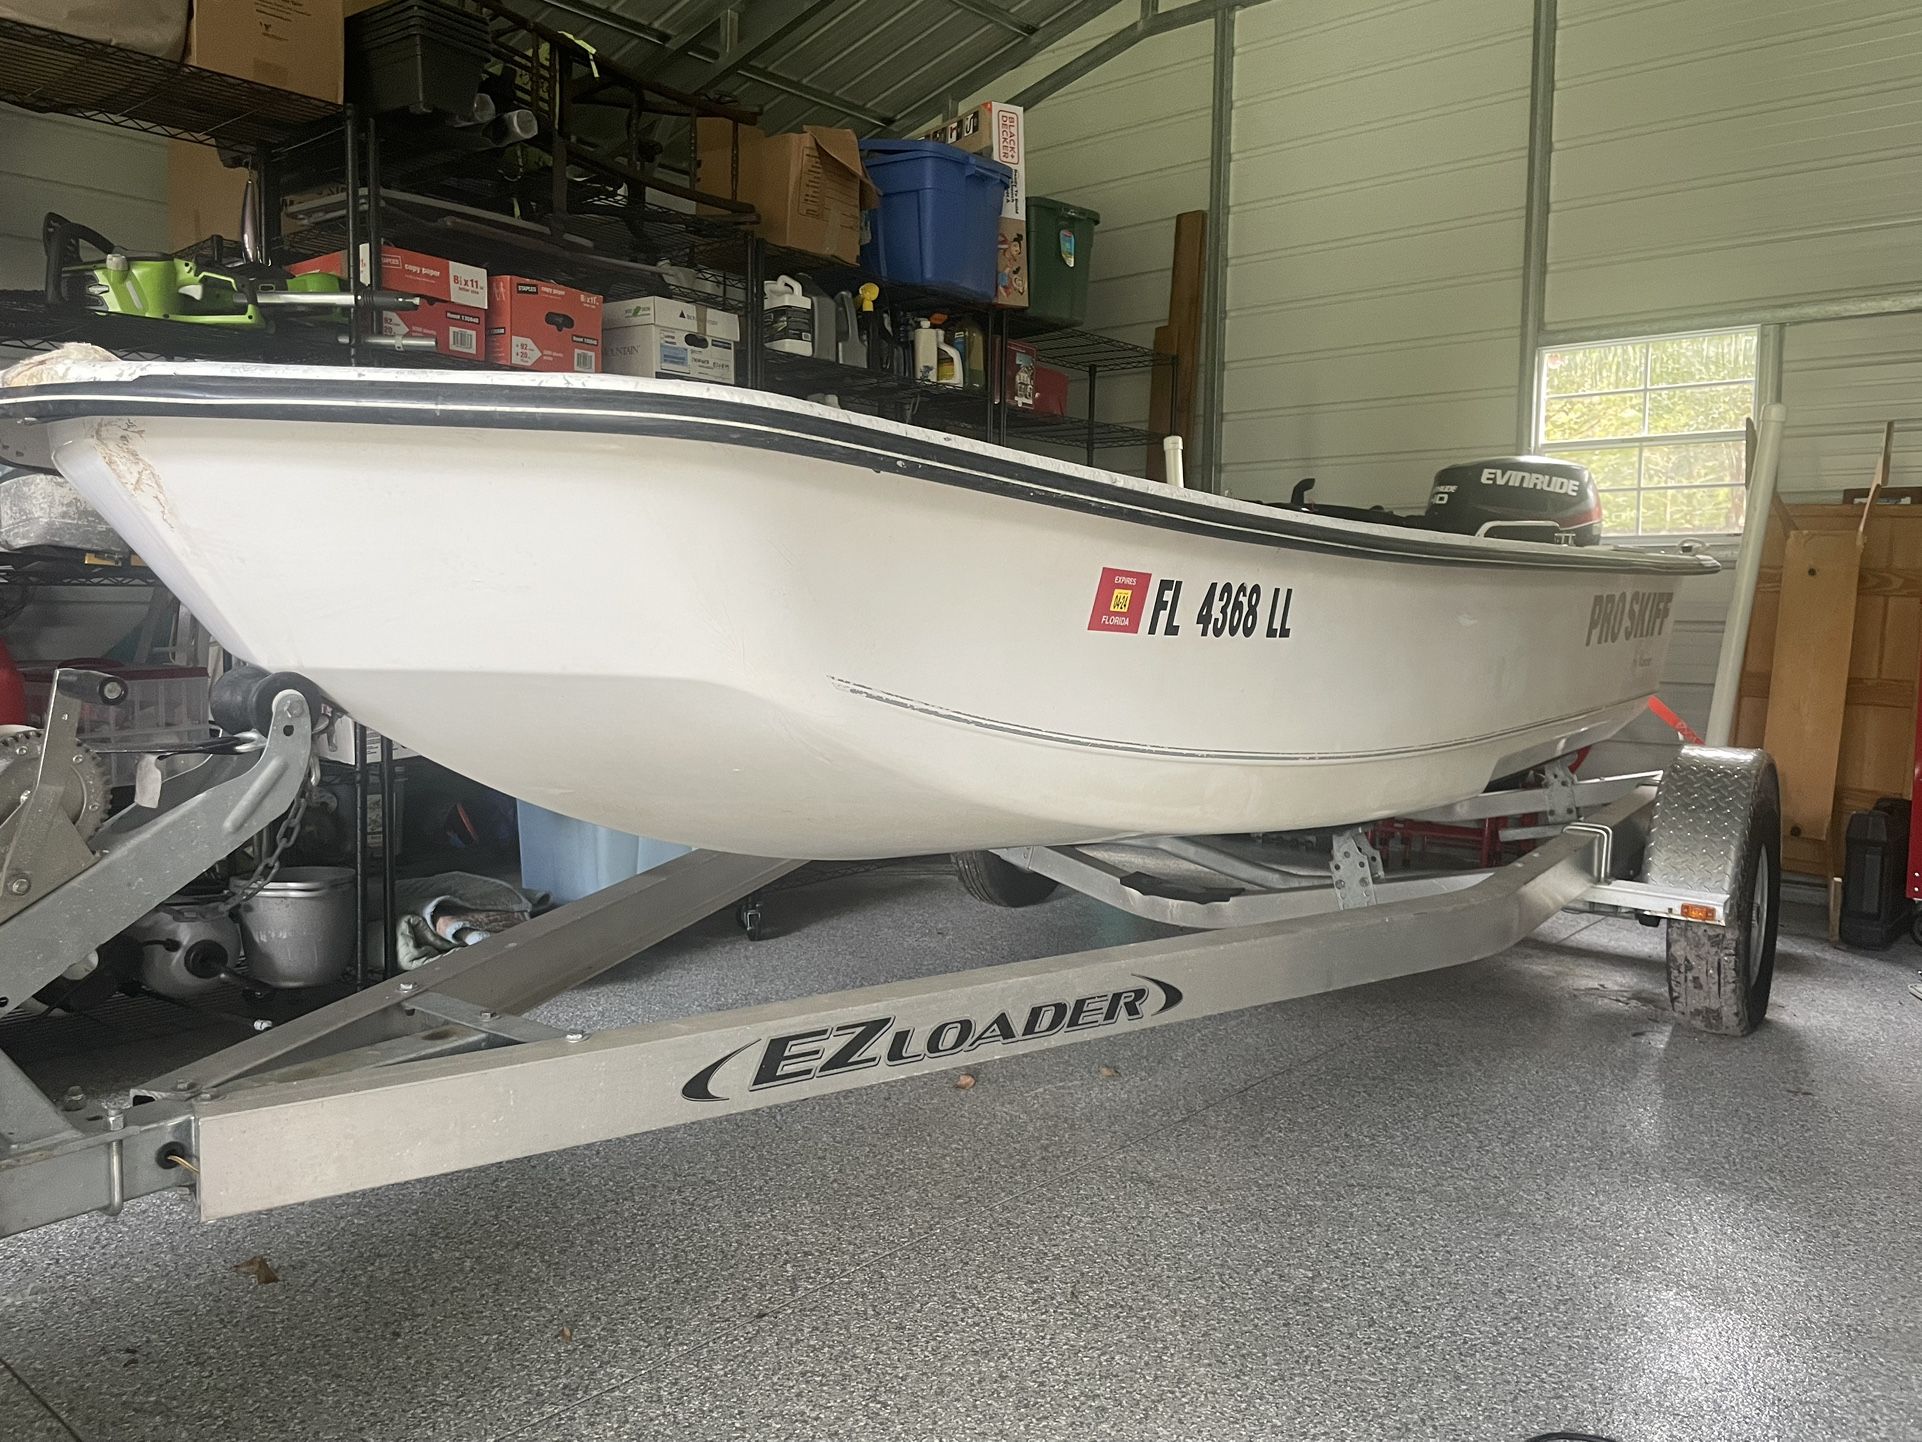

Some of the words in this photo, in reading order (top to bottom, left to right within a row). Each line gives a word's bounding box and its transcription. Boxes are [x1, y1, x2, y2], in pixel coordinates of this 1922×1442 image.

[1001, 115, 1009, 159] DECKER
[1008, 116, 1016, 160] BLACK+
[404, 263, 421, 274] copy
[421, 267, 440, 277] paper
[1480, 468, 1580, 497] EVINRUDE
[1114, 575, 1137, 586] EXPIRES
[1101, 615, 1130, 626] FLORIDA
[1147, 578, 1183, 636] FL
[1195, 581, 1262, 638] 4368
[1265, 587, 1293, 638] LL
[1585, 591, 1627, 647] PRO
[1624, 590, 1674, 641] SKIFF
